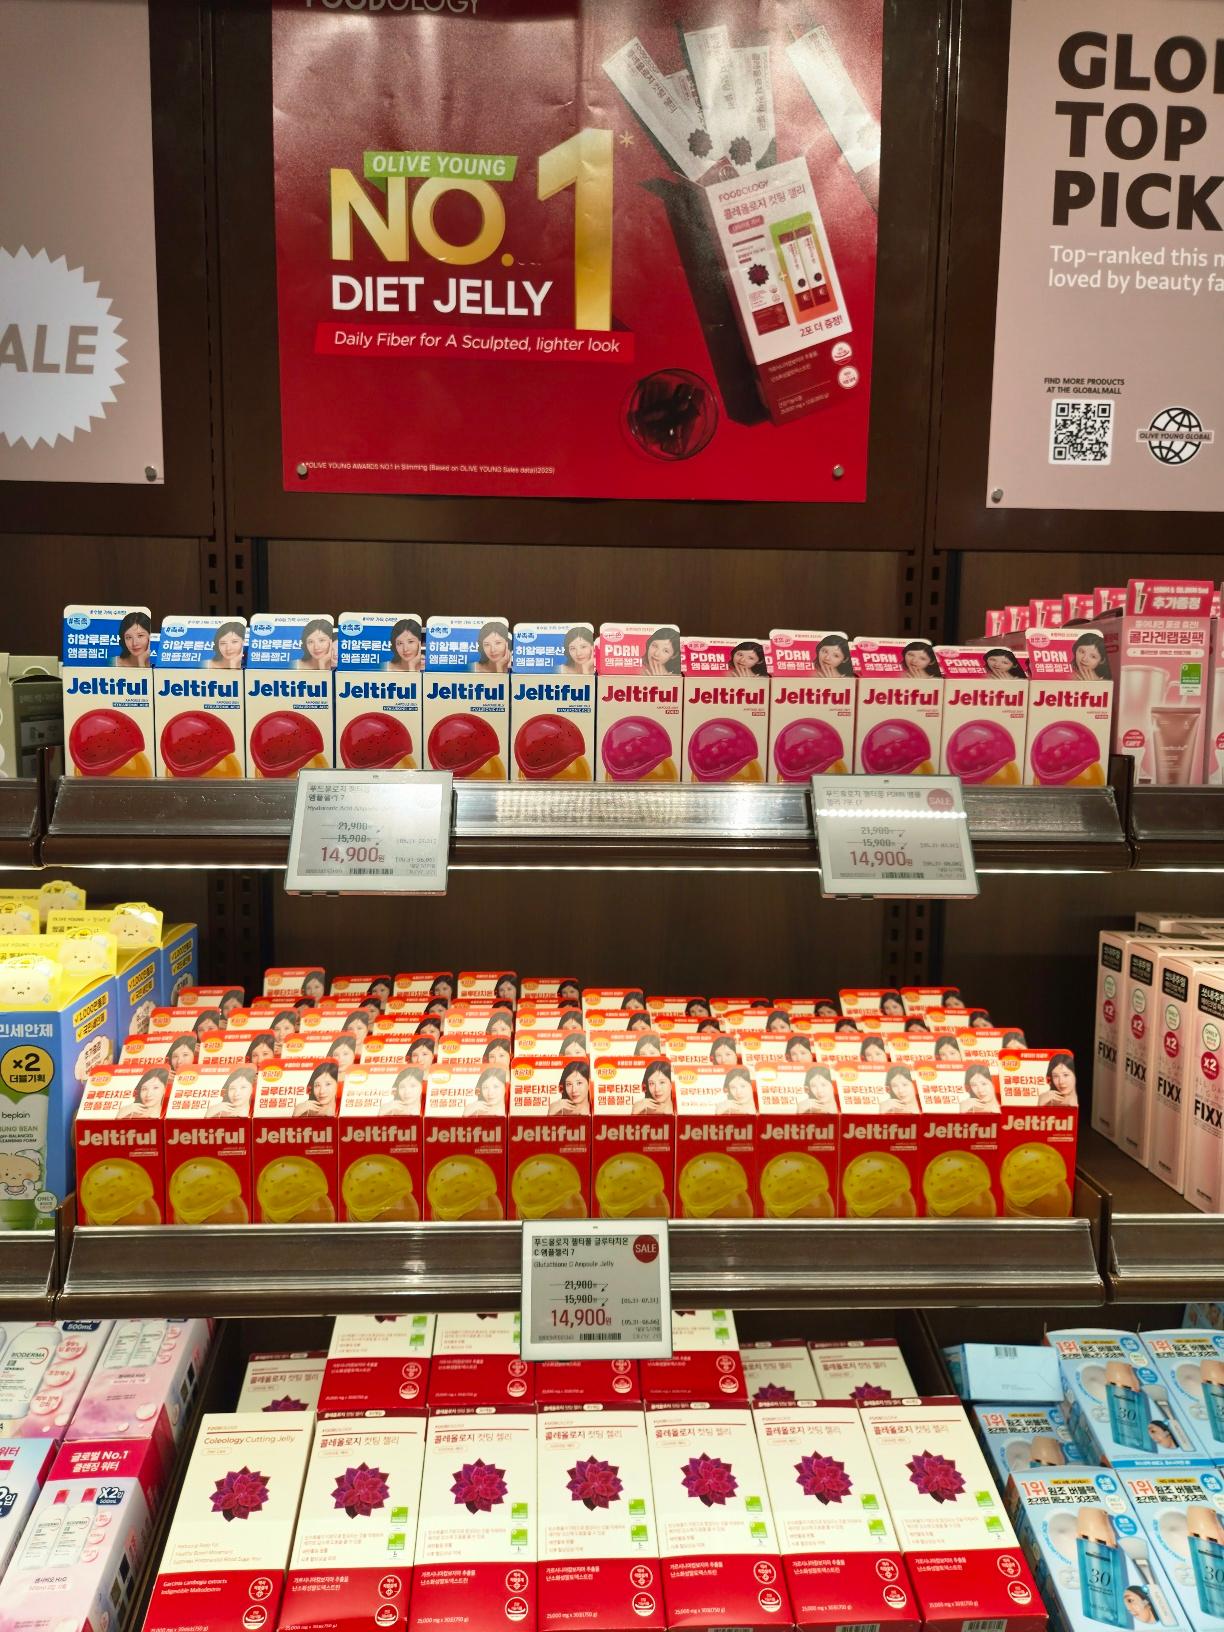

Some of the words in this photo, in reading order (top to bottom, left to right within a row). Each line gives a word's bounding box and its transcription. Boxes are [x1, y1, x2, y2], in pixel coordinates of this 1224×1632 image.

[1058, 31, 1224, 94] GLO
[1055, 100, 1207, 162] TOP
[372, 155, 430, 172] OLIVE
[437, 156, 506, 176] YOUNG
[330, 167, 514, 267] NO.
[1050, 246, 1165, 268] Top-ranked
[1170, 248, 1208, 267] this
[1049, 268, 1101, 288] loved
[1107, 270, 1130, 293] by
[1135, 271, 1203, 296] beauty
[332, 275, 424, 312] DIET
[433, 278, 553, 317] JELLY
[334, 331, 373, 348] Daily
[377, 333, 416, 347] Fiber
[420, 333, 442, 348] for
[445, 334, 458, 348] A
[462, 335, 532, 352] Sculpted,
[536, 336, 582, 356] lighter
[588, 338, 620, 353] look
[1087, 378, 1125, 386] PRODUCTS
[605, 644, 640, 657] PDRN
[690, 652, 725, 663] PDRN
[775, 650, 811, 662] PDRN
[863, 653, 897, 663] PDRN
[1033, 650, 1068, 662] PDRN
[945, 658, 980, 667] PDRN
[66, 677, 148, 695] Jeltiful
[158, 680, 239, 698] Jeltiful
[248, 679, 328, 698] Jeltiful
[338, 681, 417, 700] Jeltiful
[426, 682, 505, 701] Jeltiful
[513, 683, 591, 702] Jeltiful
[601, 685, 679, 703] Jeltiful
[688, 687, 765, 705] Jeltiful
[774, 688, 851, 705] Jeltiful
[863, 689, 939, 706] Jeltiful
[948, 690, 1024, 707] Jeltiful
[1033, 691, 1109, 708] Jeltiful
[1098, 1041, 1117, 1064] FIXX
[1125, 1057, 1146, 1082] FIXX
[1157, 1076, 1181, 1104] FIXX
[2, 1111, 30, 1120] beplain
[1193, 1099, 1223, 1128] FIXX
[595, 1124, 670, 1141] Jeltiful
[679, 1123, 753, 1141] Jeltiful
[760, 1123, 835, 1141] Jeltiful
[843, 1123, 917, 1140] Jeltiful
[923, 1122, 997, 1140] Jeltiful
[1001, 1115, 1073, 1132] Jeltiful
[78, 1129, 157, 1146] Jeltiful
[168, 1128, 245, 1146] Jeltiful
[255, 1126, 332, 1144] Jeltiful
[341, 1125, 417, 1142] Jeltiful
[426, 1126, 501, 1143] Jeltiful
[511, 1125, 586, 1142] Jeltiful
[635, 1243, 657, 1253] SALE
[551, 1308, 612, 1328] 14,900원
[204, 1436, 244, 1445] Coleology
[245, 1435, 276, 1444] Cutting
[277, 1435, 295, 1444] Jelly
[71, 1451, 101, 1462] 글로벌
[101, 1450, 129, 1460] No.1
[72, 1463, 100, 1473] 클렌징
[101, 1461, 120, 1472] 워터
[1021, 1480, 1047, 1496] 1위
[1128, 1480, 1156, 1495] 1위
[1088, 1568, 1112, 1586] 30
